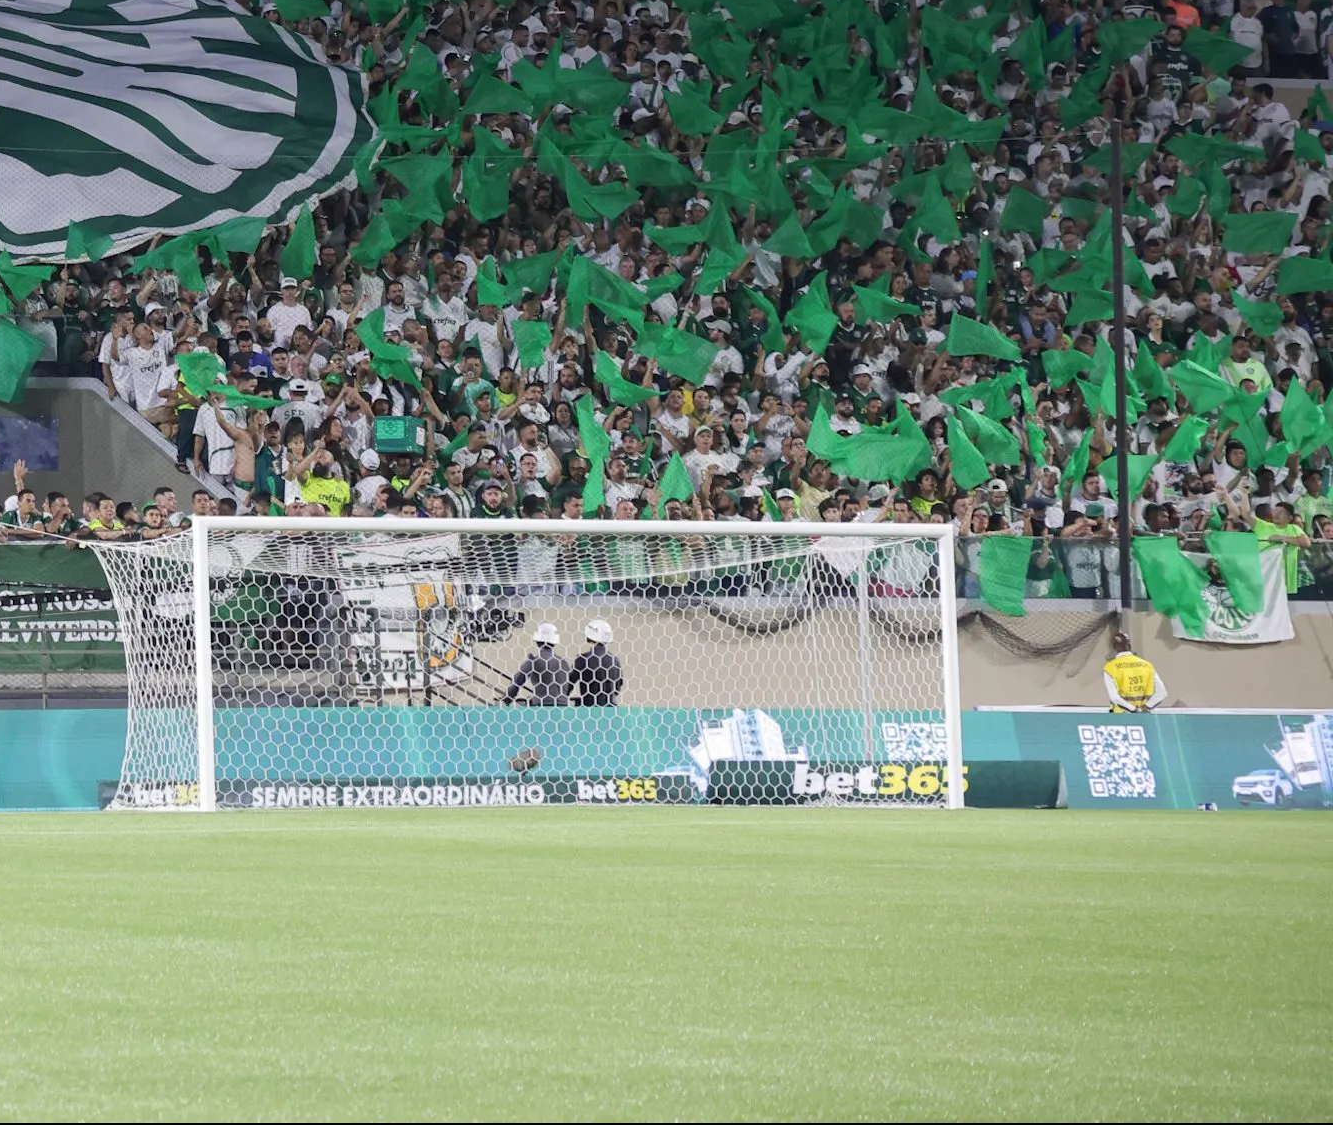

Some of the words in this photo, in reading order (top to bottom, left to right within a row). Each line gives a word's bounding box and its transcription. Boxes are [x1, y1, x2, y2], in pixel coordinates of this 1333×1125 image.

[135, 784, 201, 807] bet36
[251, 786, 335, 807] SEMPRE
[340, 782, 545, 807] EXTRAORDINÁRIO
[576, 778, 657, 802] bet365
